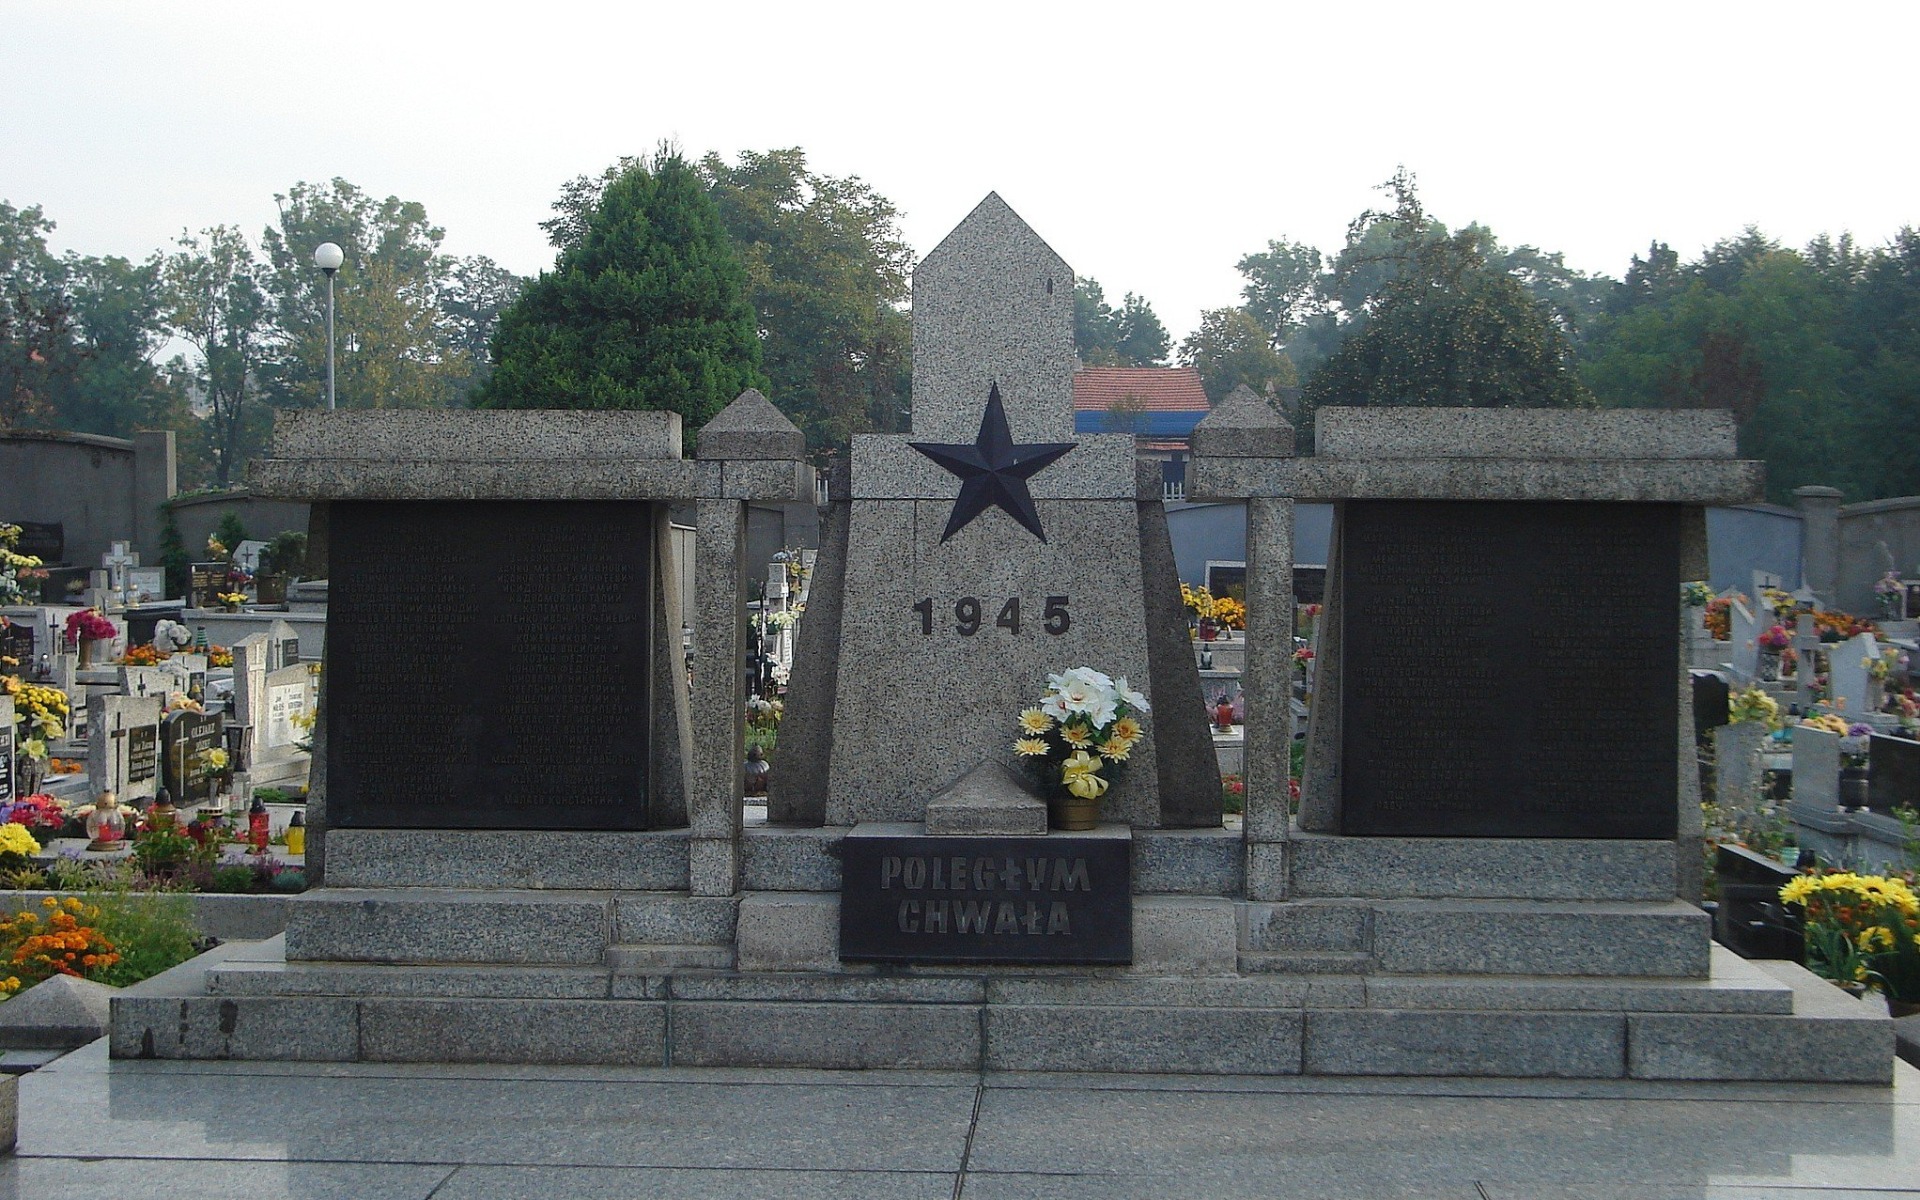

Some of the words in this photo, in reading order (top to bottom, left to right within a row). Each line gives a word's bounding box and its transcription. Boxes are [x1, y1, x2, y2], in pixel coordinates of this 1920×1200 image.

[914, 597, 1070, 636] 1945
[881, 857, 1092, 891] POLEGŁYM
[898, 899, 1072, 936] CHWAŁA
